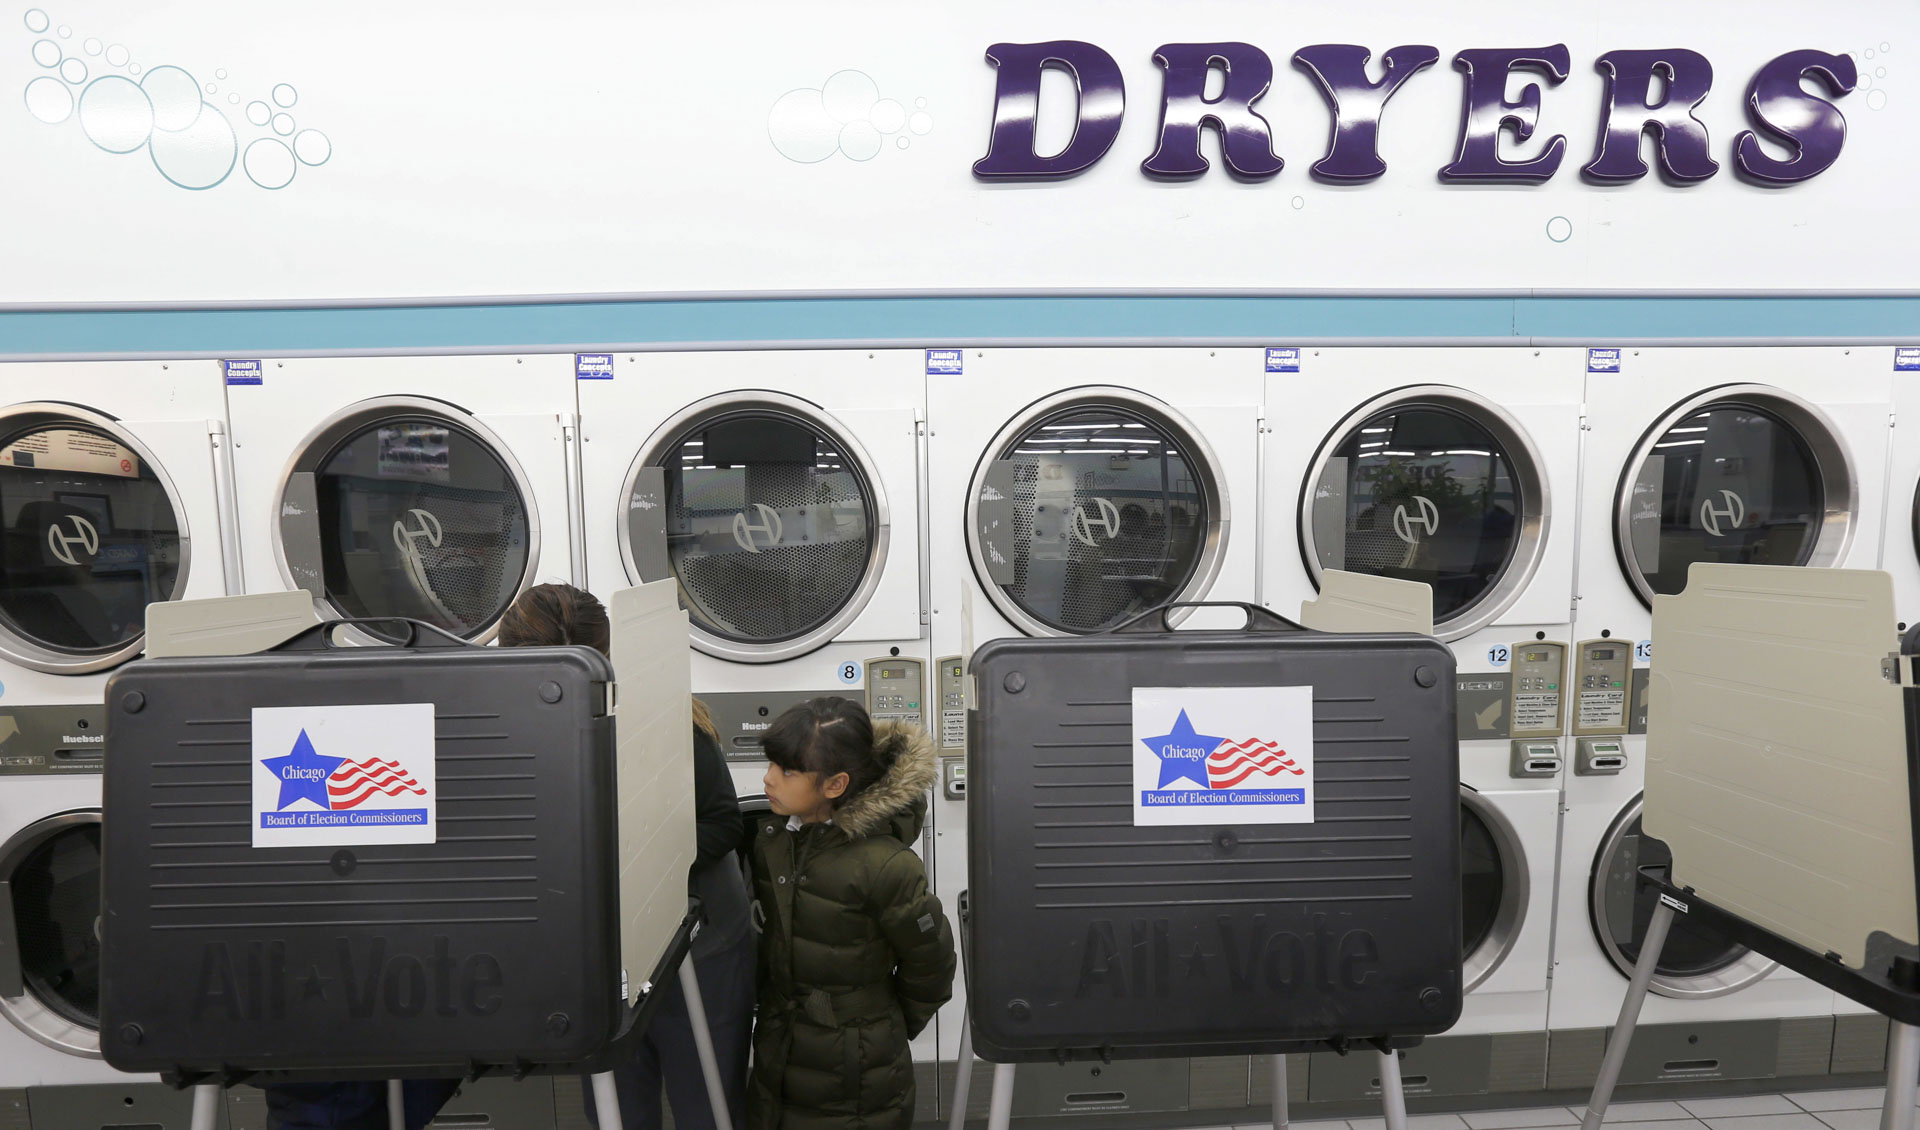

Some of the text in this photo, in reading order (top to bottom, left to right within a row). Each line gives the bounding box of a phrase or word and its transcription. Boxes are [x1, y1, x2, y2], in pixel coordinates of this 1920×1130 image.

[971, 39, 1858, 187] DRYERS
[930, 351, 958, 360] Laundry
[229, 361, 257, 370] Laundry
[227, 369, 261, 378] Concepts
[1489, 648, 1507, 662] 12
[843, 665, 855, 679] 8
[882, 670, 889, 678] 8
[954, 668, 961, 676] 9
[741, 722, 769, 731] Hueb
[1162, 744, 1206, 763] Chicago
[282, 765, 326, 783] Chicago
[1147, 791, 1300, 804] Board of Election Commissioners
[266, 812, 422, 826] Board of Election Commissioners
[1074, 911, 1380, 1001] All Vote
[196, 934, 503, 1022] All Vote
